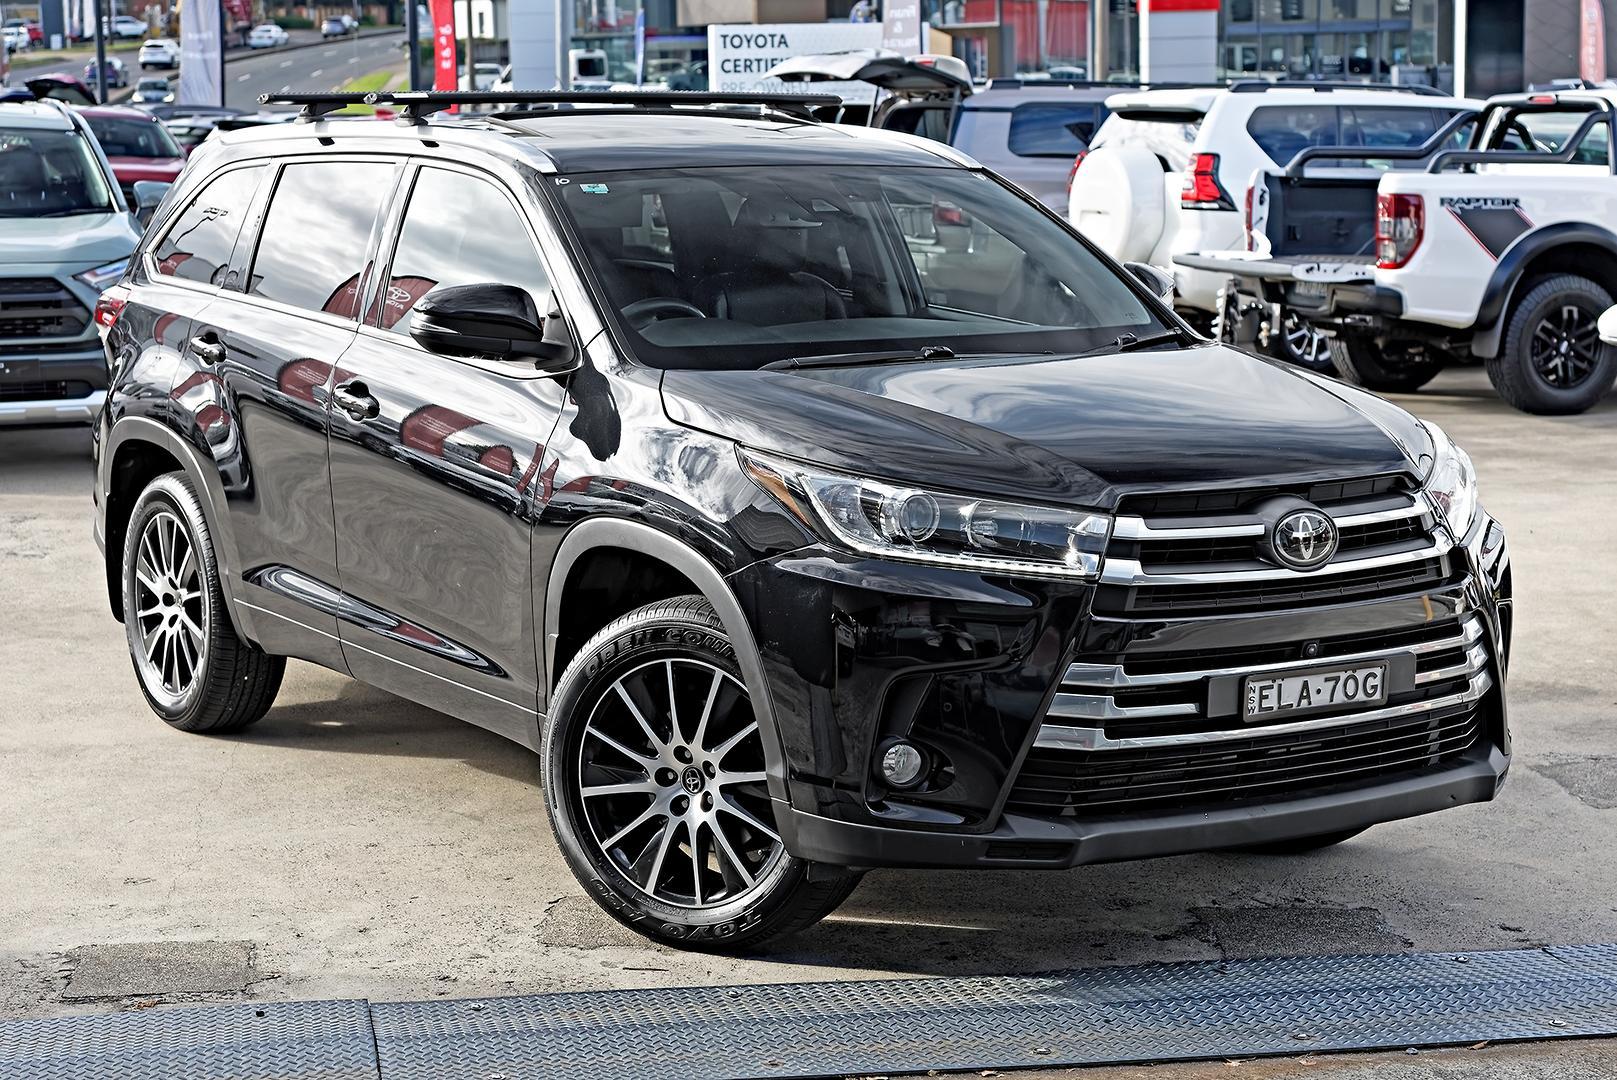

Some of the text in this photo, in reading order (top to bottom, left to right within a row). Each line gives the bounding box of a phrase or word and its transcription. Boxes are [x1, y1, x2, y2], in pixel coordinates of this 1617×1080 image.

[720, 34, 789, 49] TOYOTA
[720, 57, 793, 74] CERTIF
[1440, 197, 1520, 208] RAPTOR
[584, 627, 738, 680] OPEN COUN
[1247, 685, 1257, 715] NSW
[659, 909, 763, 941] TOYO
